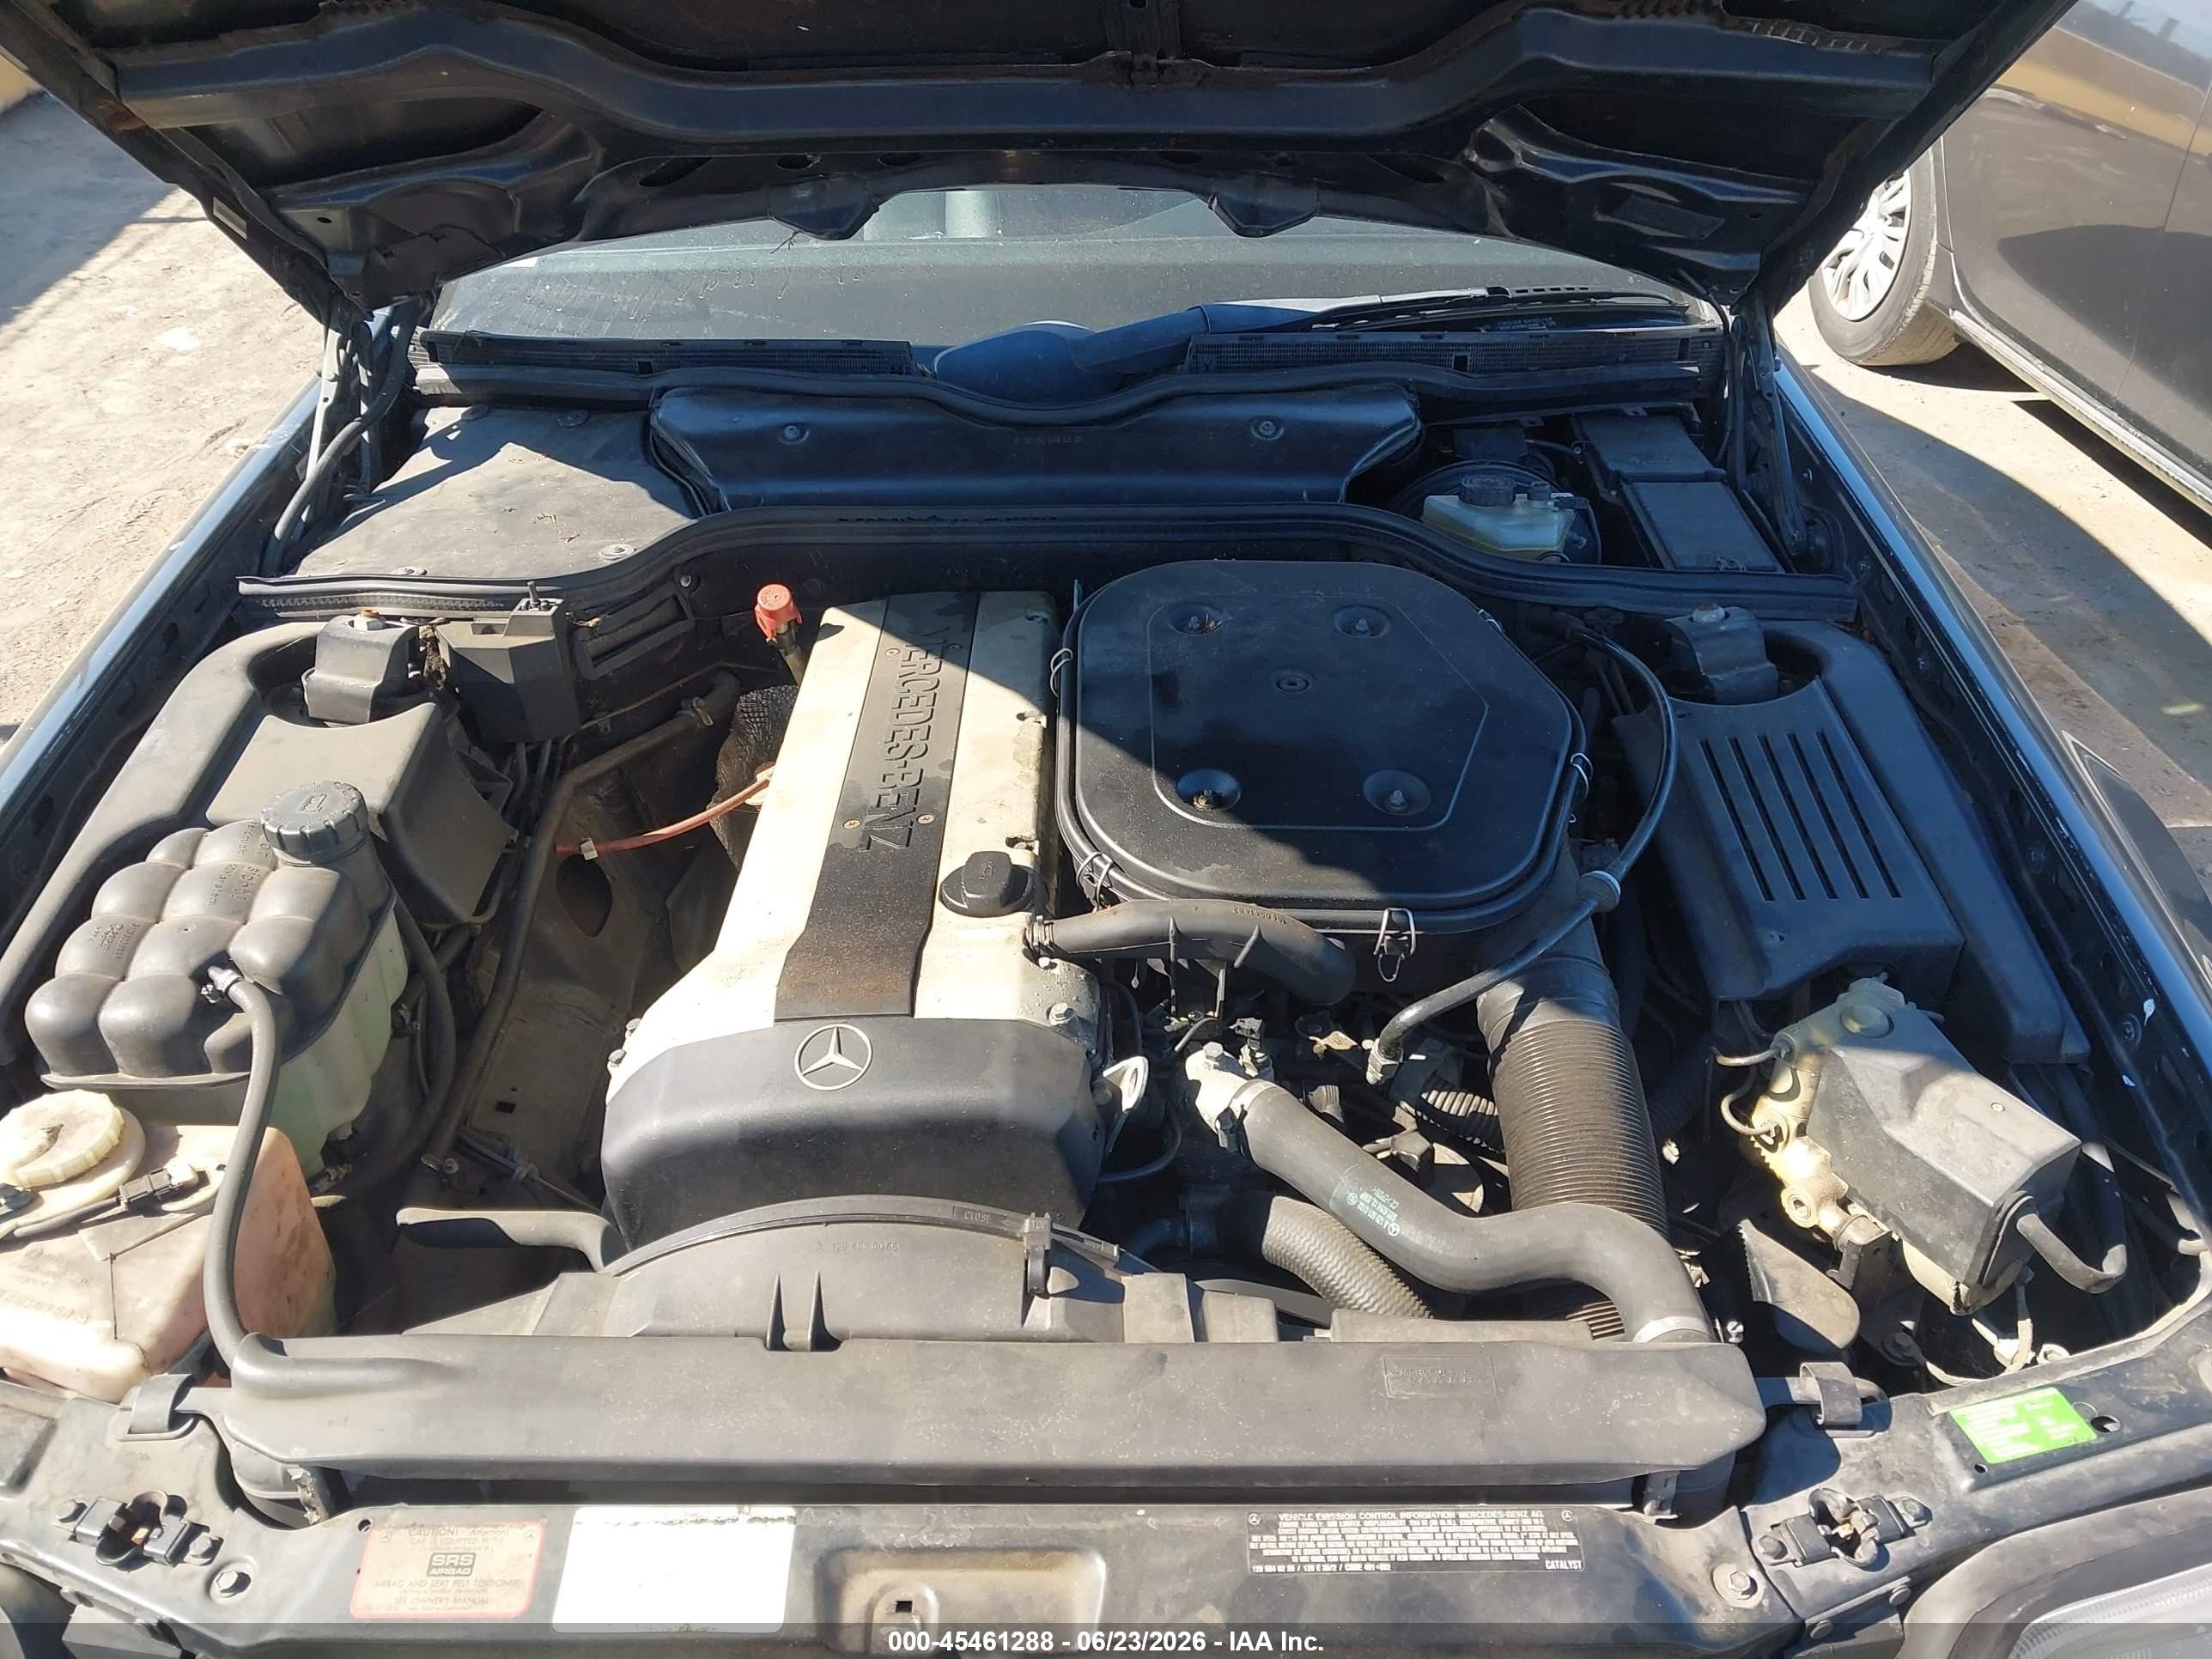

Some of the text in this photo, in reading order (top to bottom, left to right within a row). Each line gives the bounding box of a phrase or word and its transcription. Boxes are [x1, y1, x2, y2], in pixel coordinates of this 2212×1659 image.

[1315, 1512, 1357, 1521] EMISSION
[1358, 1511, 1397, 1520] CONTROL
[1400, 1510, 1456, 1519] INFORMATION
[1458, 1510, 1529, 1518] MERCEDES-BENZ
[408, 1528, 459, 1537] CAUTION!
[481, 1536, 503, 1545] WITH
[430, 1553, 474, 1566] SRS
[1545, 1559, 1583, 1570] CATALYST
[428, 1567, 472, 1576] AIRBAG
[408, 1579, 428, 1588] AND
[429, 1579, 450, 1588] SEAT
[453, 1579, 470, 1588] BELT
[453, 1596, 489, 1605] MANUAL
